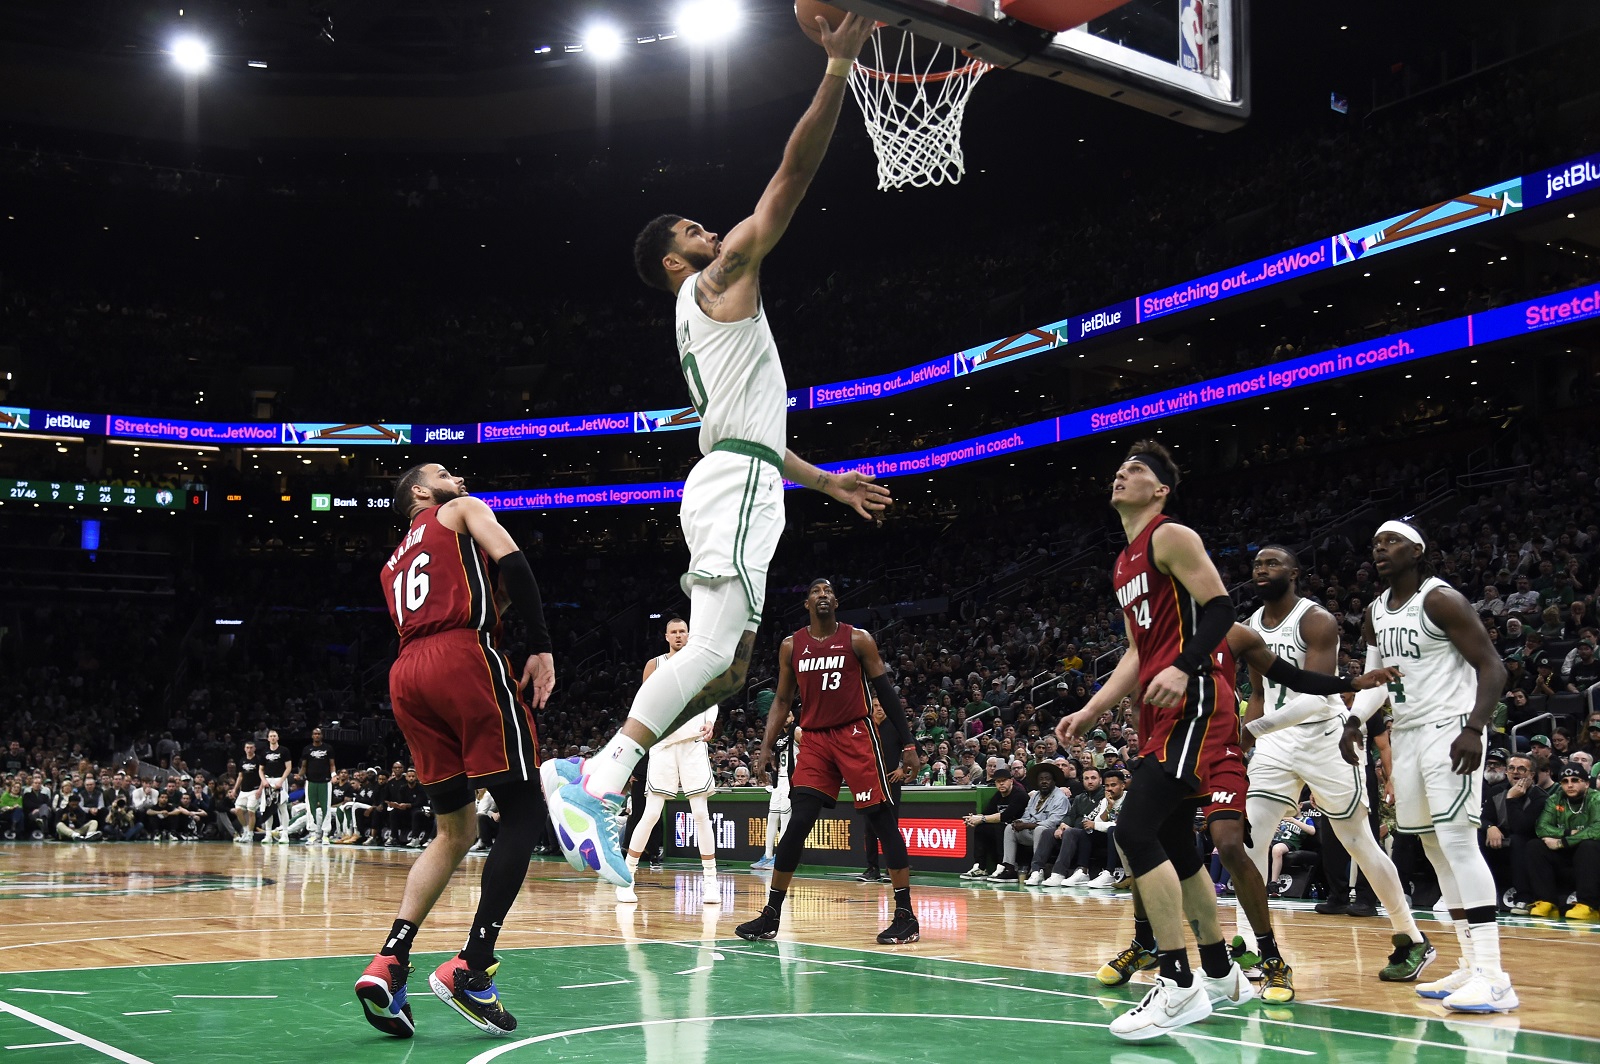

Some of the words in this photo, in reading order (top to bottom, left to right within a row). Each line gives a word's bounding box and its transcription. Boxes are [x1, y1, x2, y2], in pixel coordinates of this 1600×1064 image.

[1182, 54, 1196, 68] NBA
[1144, 283, 1219, 314] Stretching
[1221, 246, 1325, 289] out...JetWoo!
[1080, 312, 1121, 337] jetBlue
[816, 383, 881, 402] Stretching
[883, 361, 950, 390] out...JetWoo!
[1090, 404, 1139, 428] Stretch
[1141, 399, 1164, 416] out
[1166, 390, 1198, 410] with
[1200, 385, 1225, 403] the
[1227, 373, 1266, 395] most
[1268, 358, 1334, 389] legroom
[1337, 352, 1352, 370] in
[1355, 338, 1414, 365] coach.
[44, 414, 90, 429] jetBlue
[114, 419, 188, 438] Stretching
[190, 425, 276, 439] out...JetWoo!
[484, 422, 547, 438] Stretching
[548, 416, 629, 433] out...JetWoo!
[425, 428, 465, 442] jetBlue
[876, 460, 897, 474] the
[899, 456, 930, 470] most
[931, 446, 974, 468] legroom
[975, 442, 986, 456] in
[987, 433, 1024, 453] coach.
[52, 490, 59, 500] 9
[77, 491, 84, 501] 5
[100, 493, 112, 503] 26
[123, 495, 136, 505] 42
[192, 495, 199, 505] 8
[313, 496, 330, 508] TD
[334, 498, 357, 507] Bank
[367, 498, 390, 508] 3:05
[502, 496, 524, 507] out
[525, 493, 552, 506] with
[553, 491, 575, 504] the
[576, 490, 608, 502] most
[609, 488, 661, 503] legroom
[663, 486, 675, 498] in
[386, 523, 426, 571] MARTIN
[393, 552, 430, 627] 16
[1131, 599, 1152, 630] 14
[1376, 626, 1421, 660] ELTICS
[798, 656, 846, 673] MIAMI
[821, 672, 842, 691] 13
[917, 827, 957, 849] NOW
